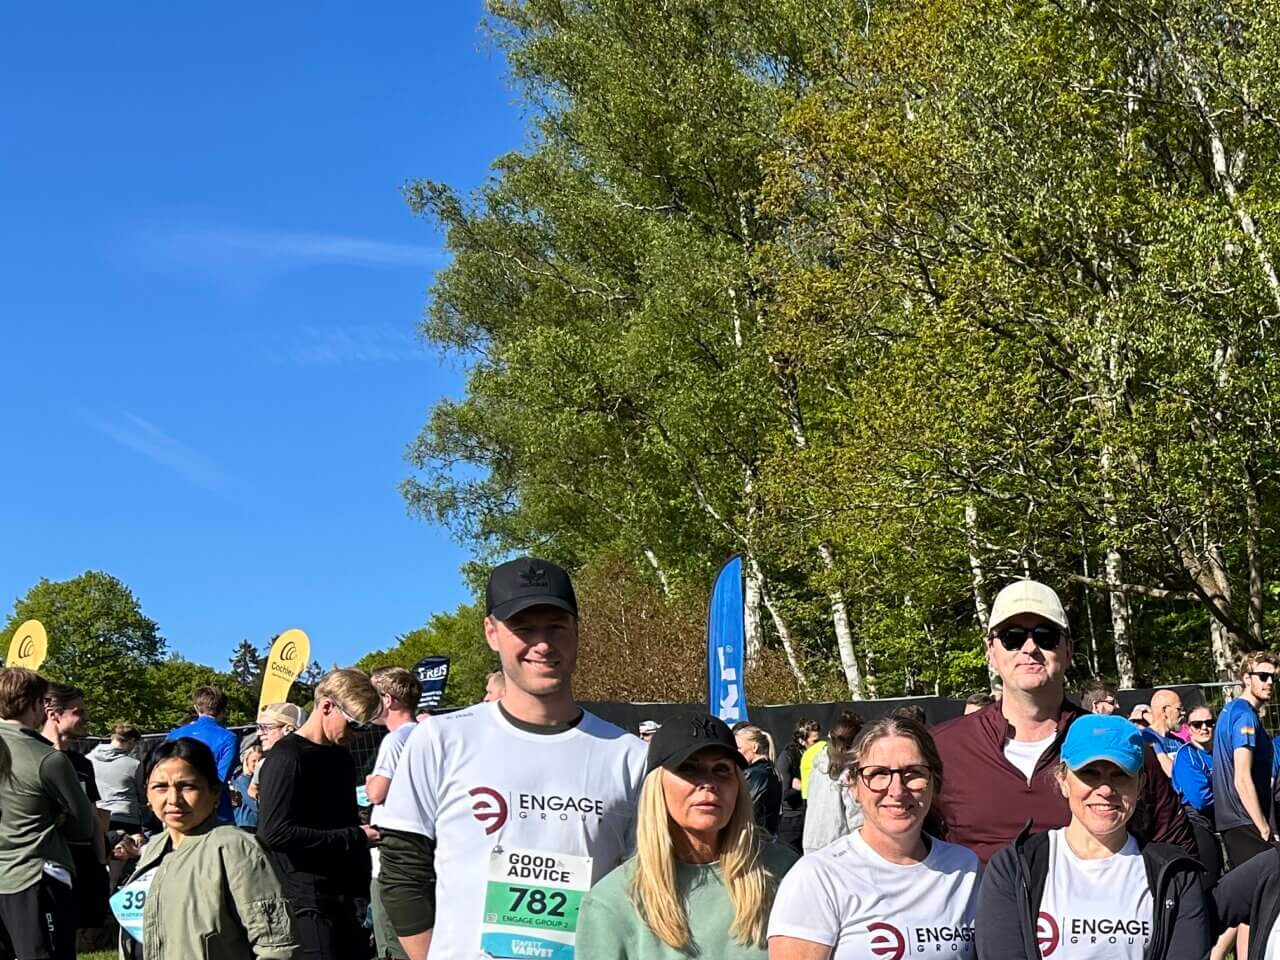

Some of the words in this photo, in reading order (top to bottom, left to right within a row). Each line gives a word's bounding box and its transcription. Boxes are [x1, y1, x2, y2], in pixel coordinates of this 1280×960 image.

[717, 646, 739, 730] KF
[519, 793, 604, 816] ENGAGE
[508, 853, 556, 869] GOOD
[507, 865, 571, 883] ADVICE
[508, 887, 568, 917] 782
[1071, 918, 1150, 936] ENGAGE
[916, 943, 972, 953] GROU
[1070, 936, 1149, 946] GROUP
